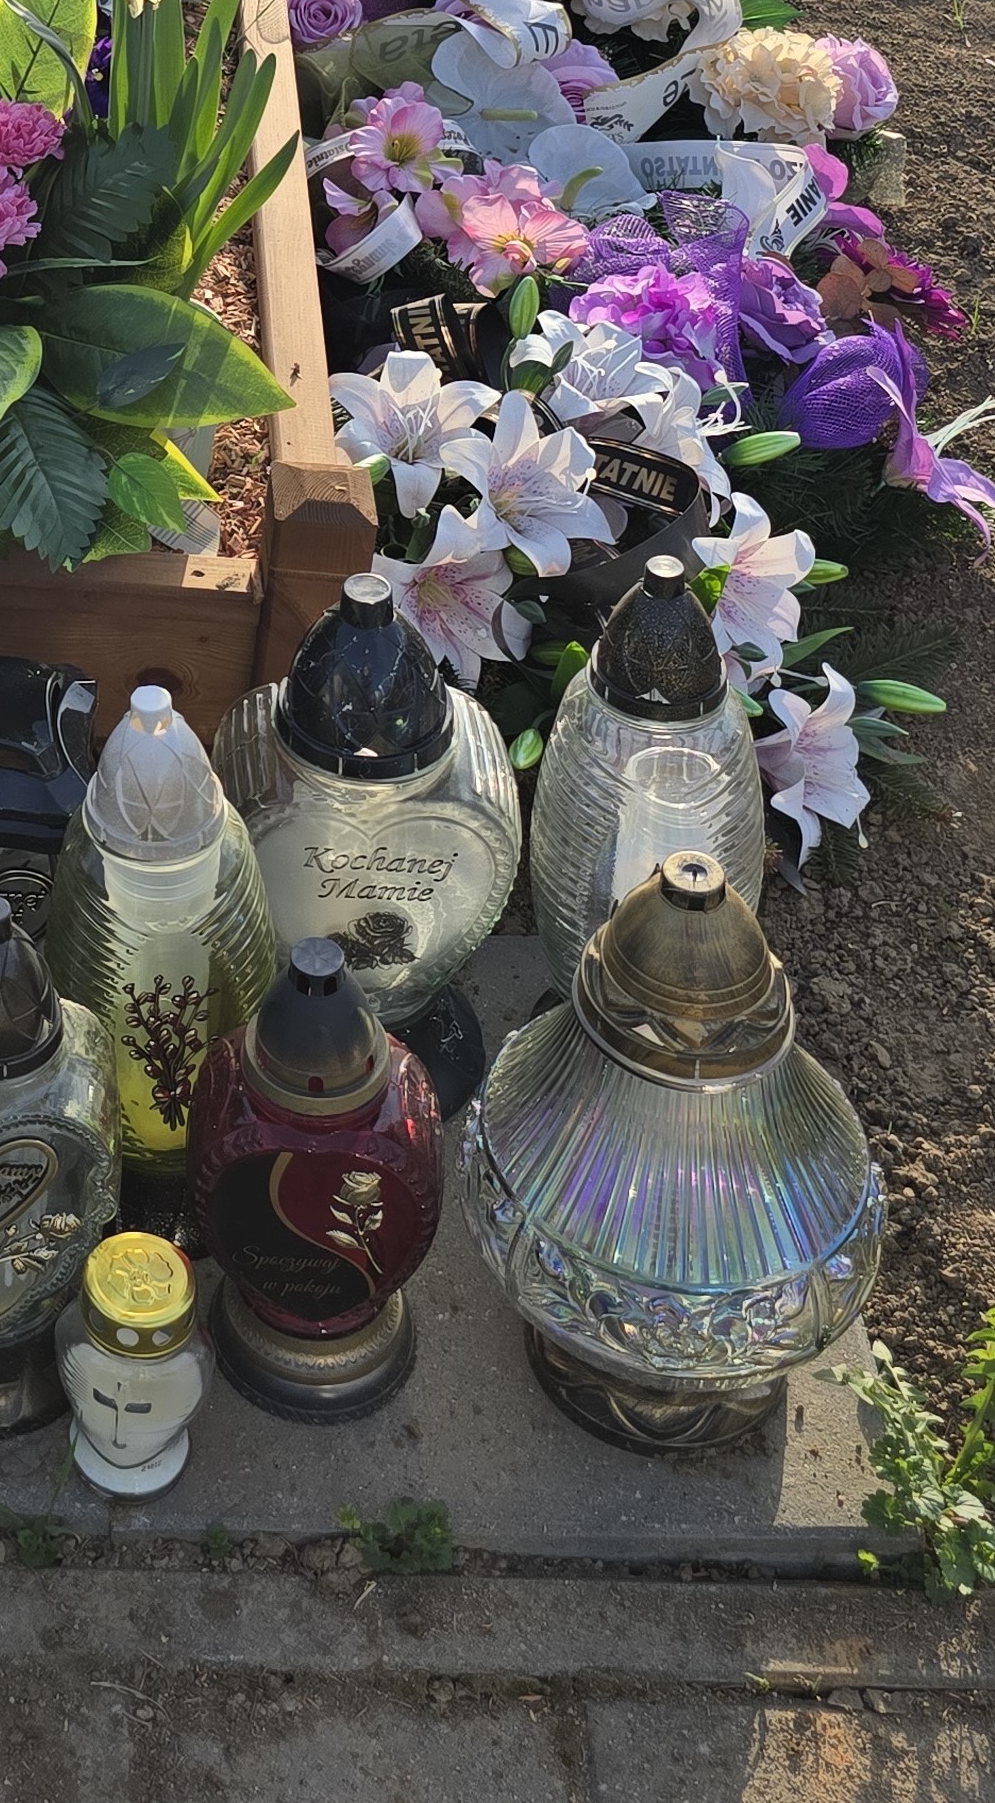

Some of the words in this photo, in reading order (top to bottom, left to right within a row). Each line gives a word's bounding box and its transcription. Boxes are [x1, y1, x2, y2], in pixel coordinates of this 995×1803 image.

[785, 175, 822, 227] ANIE
[594, 454, 678, 502] TATNIE
[303, 846, 459, 882] Kochanej
[317, 878, 434, 902] Mamie
[232, 1245, 339, 1275] Spoczywaj
[263, 1280, 277, 1290] w
[281, 1279, 343, 1299] pokoju
